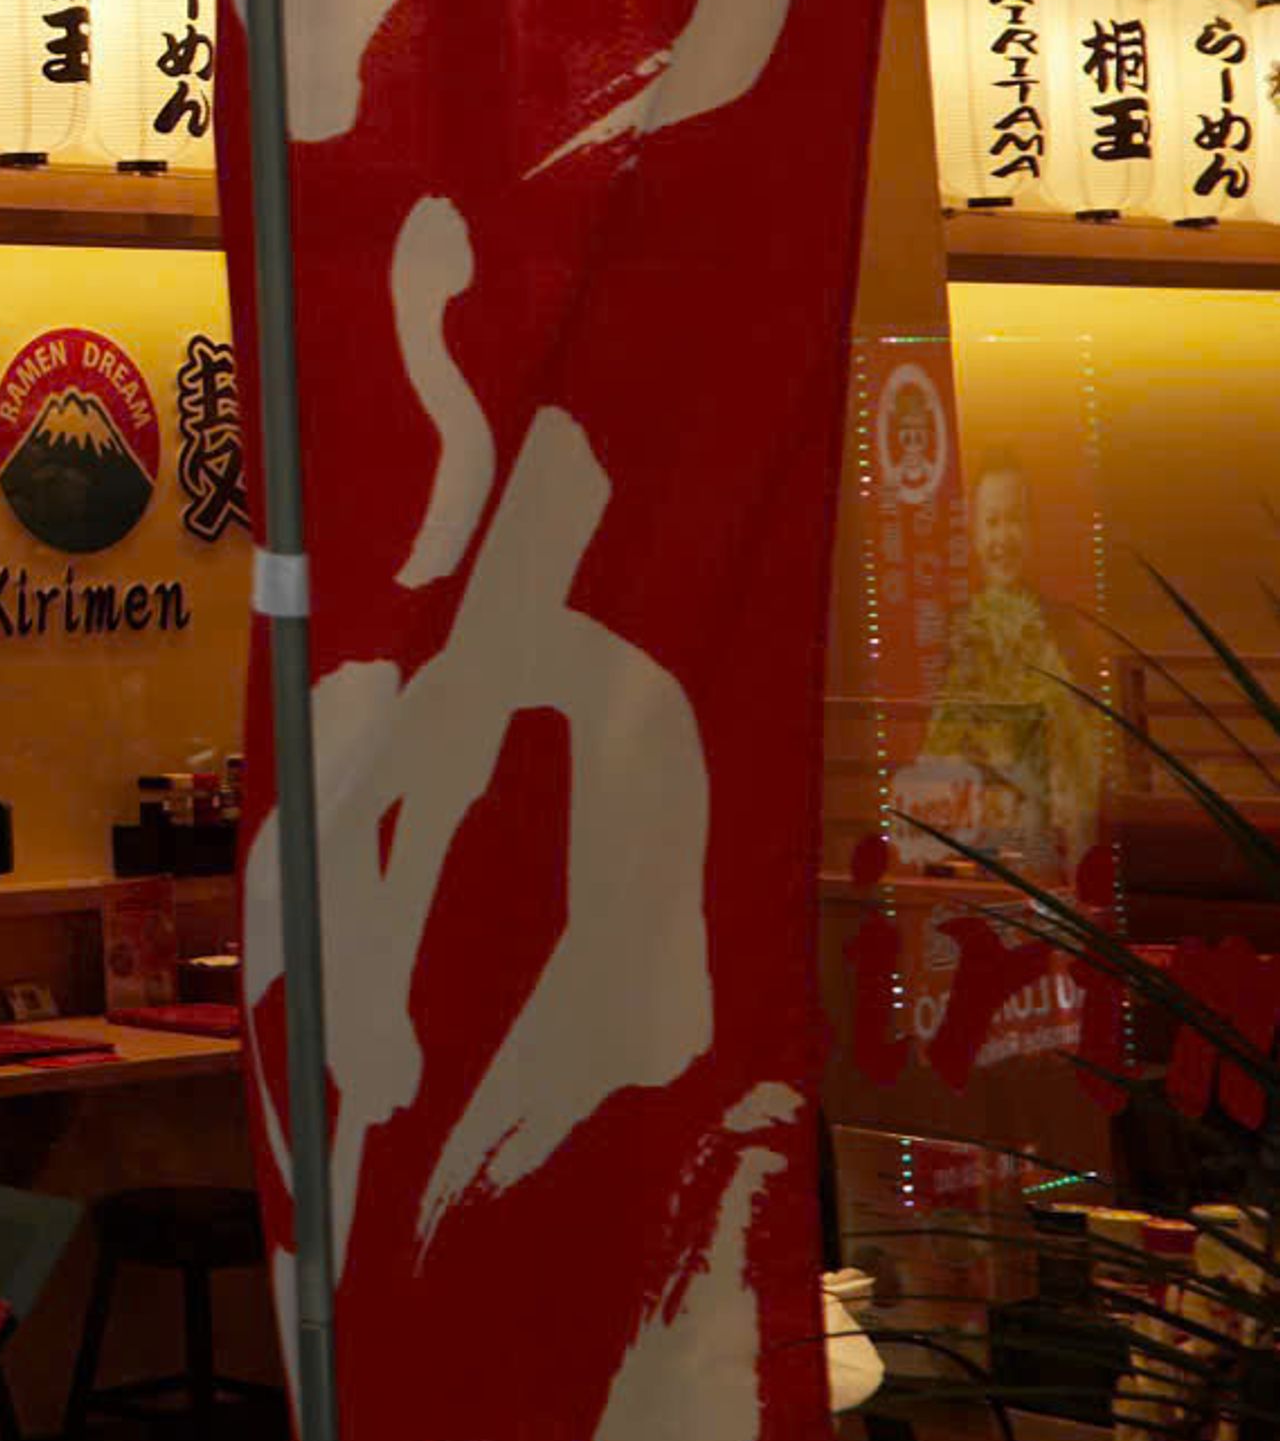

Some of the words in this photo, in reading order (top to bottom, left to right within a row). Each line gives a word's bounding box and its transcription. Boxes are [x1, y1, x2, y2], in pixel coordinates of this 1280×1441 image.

[1192, 14, 1252, 199] らーめん
[81, 340, 153, 431] DREAM
